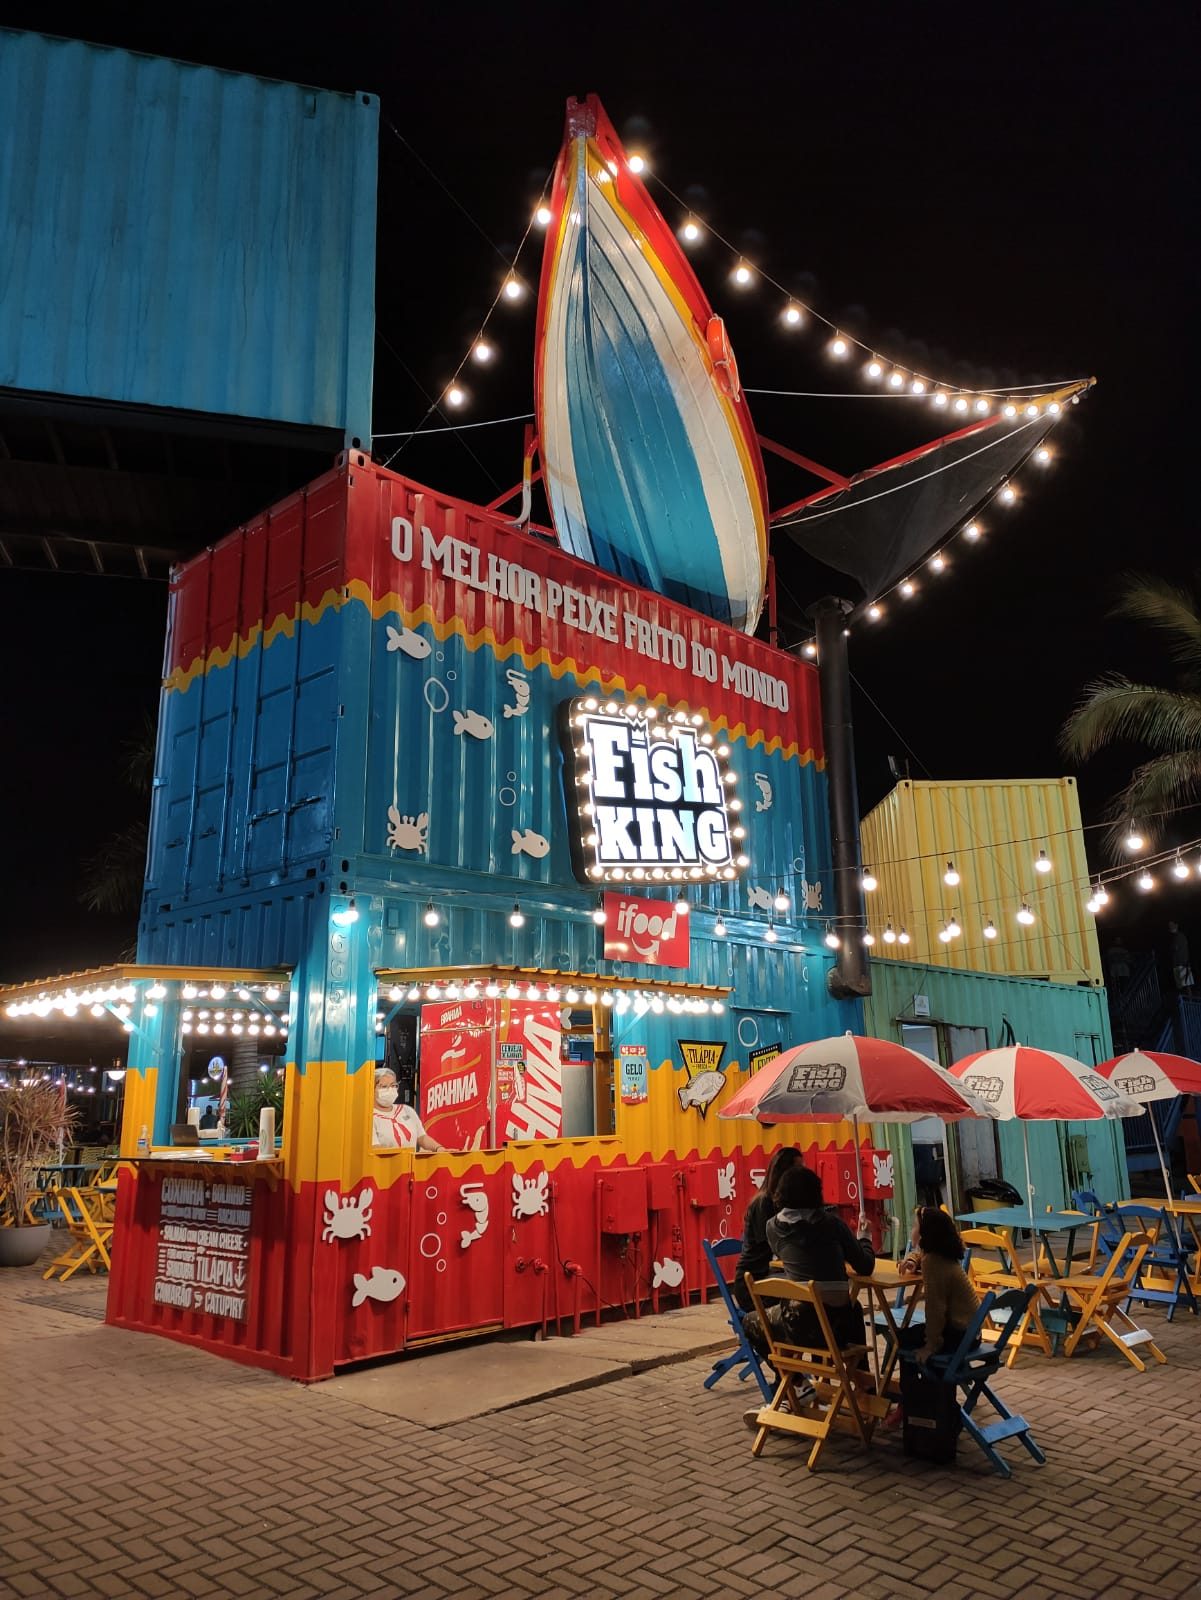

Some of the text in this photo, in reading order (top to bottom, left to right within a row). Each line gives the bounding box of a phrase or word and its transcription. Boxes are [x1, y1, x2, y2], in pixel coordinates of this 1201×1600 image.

[391, 516, 789, 713] O MELHOR PEIXE FRITO DO MUNDO
[588, 719, 722, 804] Fish
[596, 805, 731, 861] KING
[617, 901, 677, 938] ifood
[440, 1004, 463, 1026] BRAHMA
[625, 1063, 643, 1075] GELO
[795, 1065, 842, 1079] Fish
[427, 1071, 478, 1114] BRAHMA
[791, 1079, 842, 1090] KING
[161, 1178, 246, 1206] COXINHA BOLINHO
[198, 1229, 219, 1248] CREAM
[219, 1232, 244, 1251] CHEESE
[205, 1291, 245, 1320] CATUPIRY
